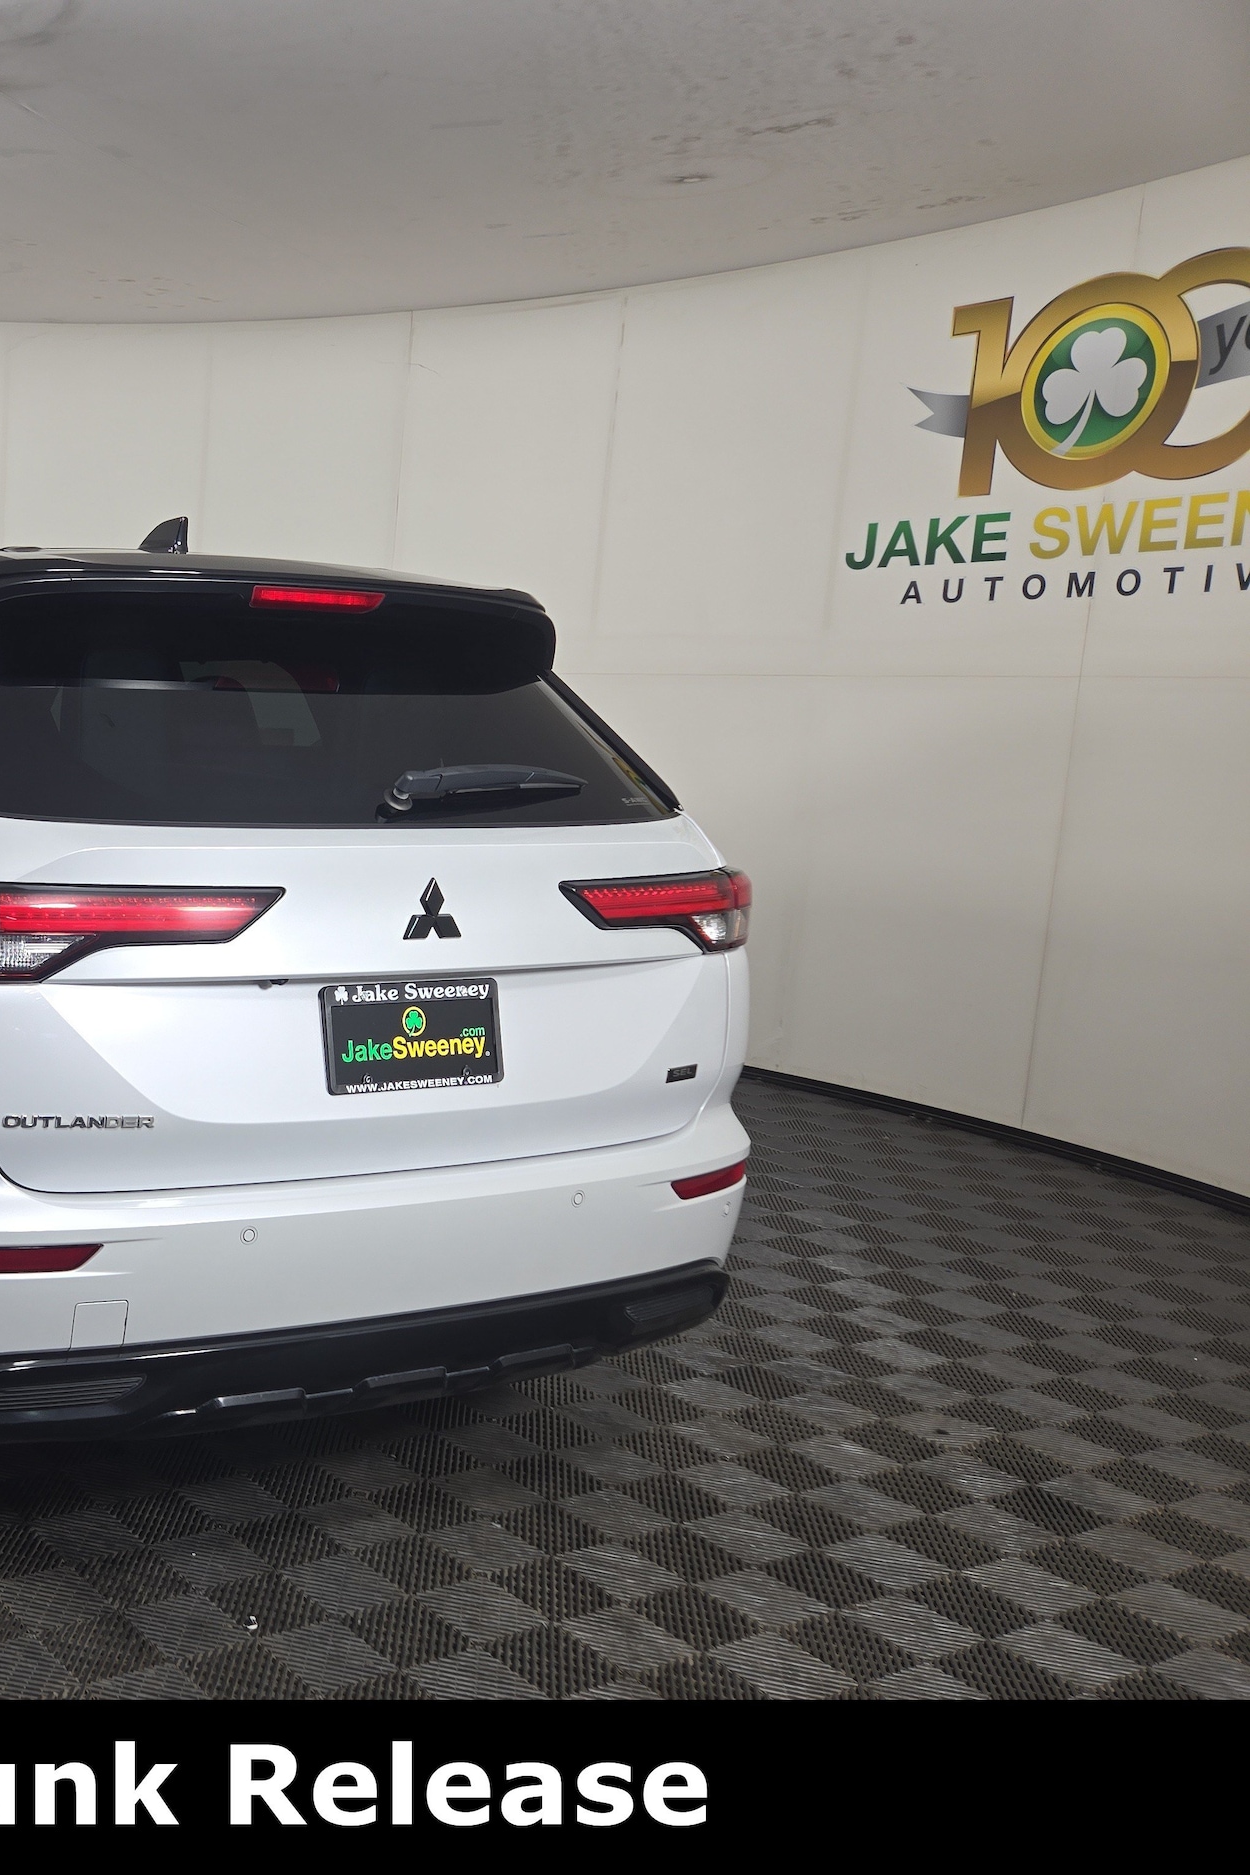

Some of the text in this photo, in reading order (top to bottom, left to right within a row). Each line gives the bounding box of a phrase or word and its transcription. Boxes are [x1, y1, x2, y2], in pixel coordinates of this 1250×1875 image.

[845, 512, 1011, 570] JAKE
[352, 983, 489, 1002] Jake Sweeney
[346, 1075, 493, 1093] WWW.JAKESWEENEY.COM
[2, 1115, 154, 1129] OUTLANDER
